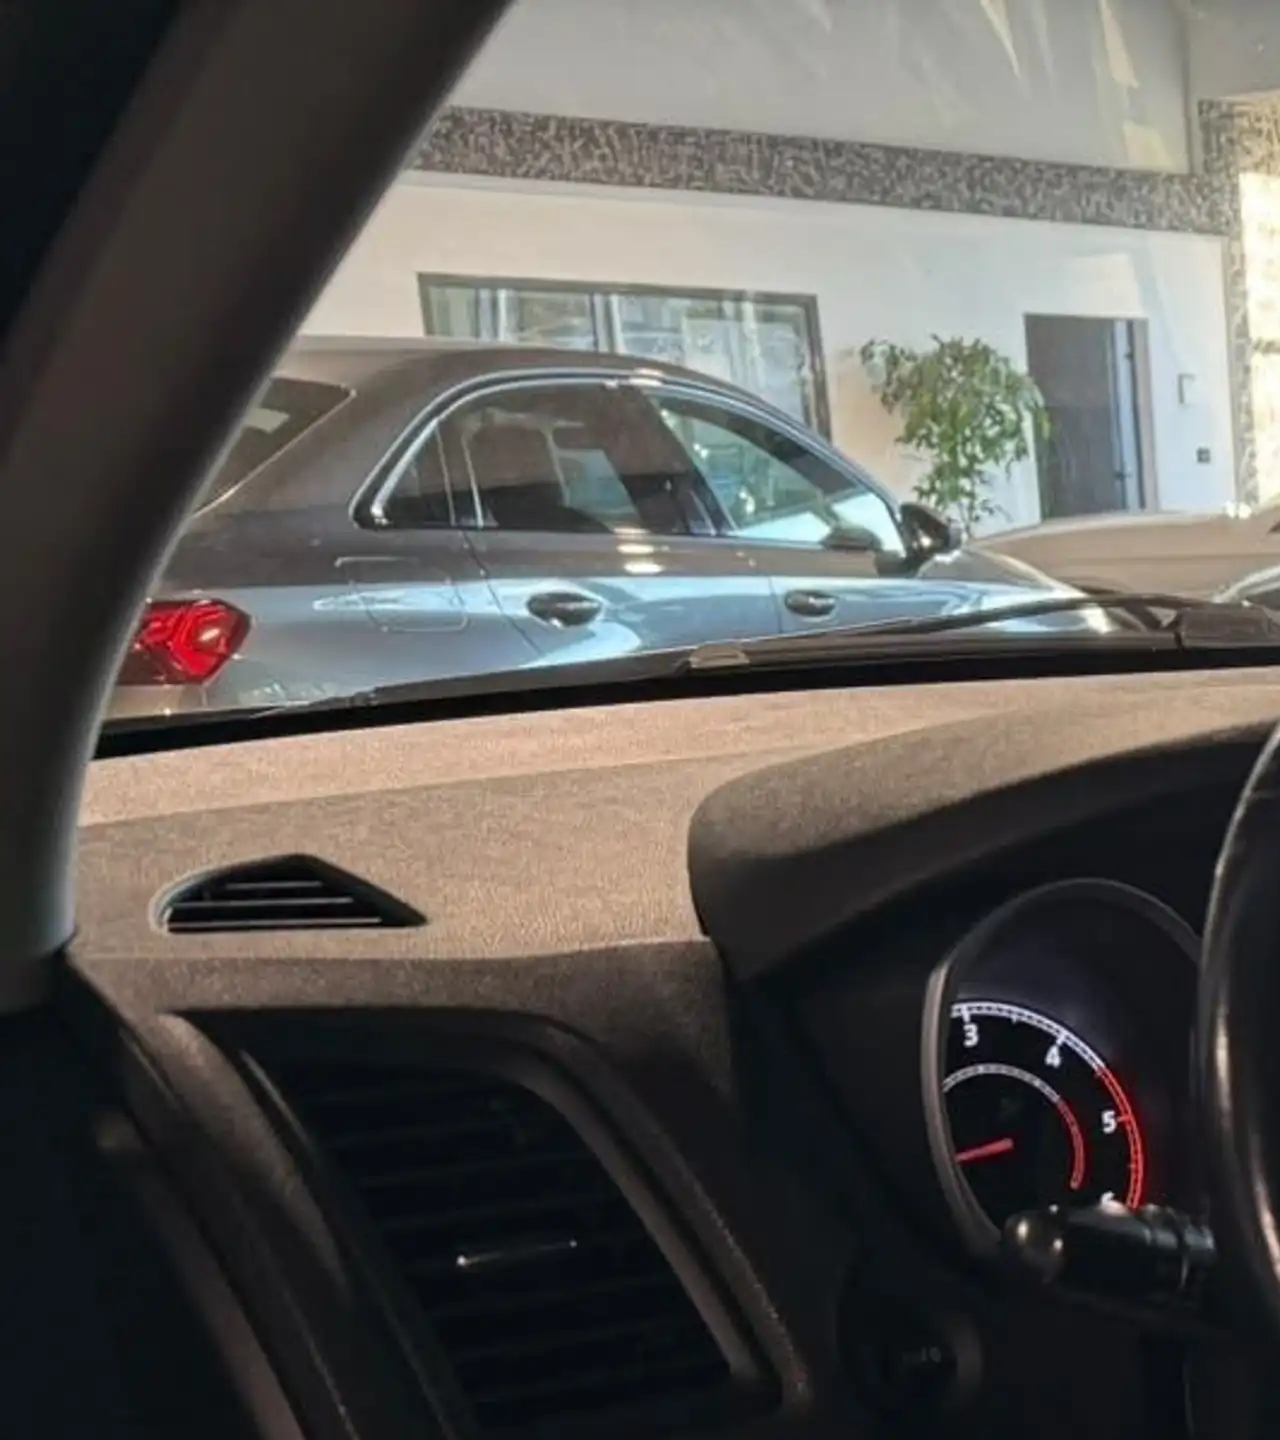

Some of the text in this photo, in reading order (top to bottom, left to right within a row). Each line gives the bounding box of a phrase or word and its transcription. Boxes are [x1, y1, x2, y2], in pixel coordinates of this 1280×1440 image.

[963, 1024, 979, 1047] 3
[1044, 1045, 1062, 1068] 4
[1101, 1110, 1118, 1134] 5
